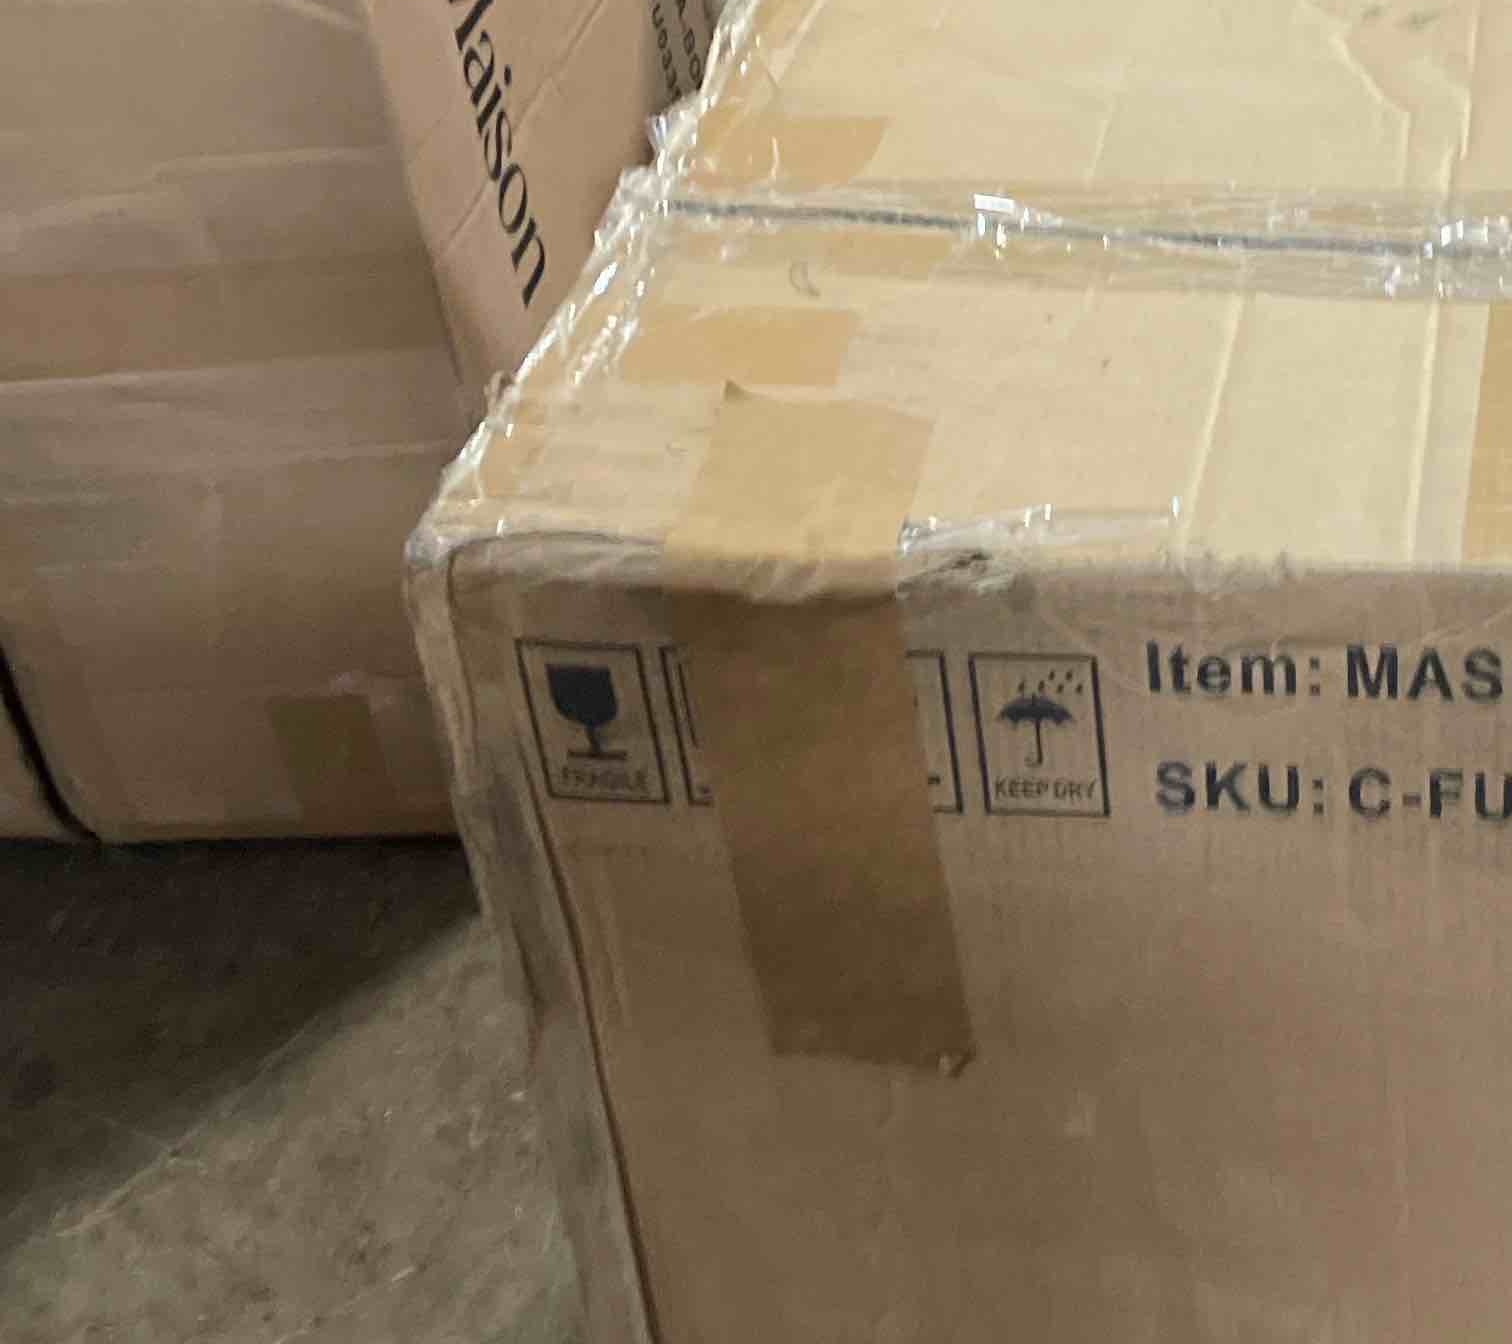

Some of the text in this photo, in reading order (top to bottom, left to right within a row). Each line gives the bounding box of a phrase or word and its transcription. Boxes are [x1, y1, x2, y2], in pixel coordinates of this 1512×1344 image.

[1144, 639, 1323, 697] Item:
[994, 775, 1098, 803] KEEP DRY
[1154, 760, 1326, 817] SKU:
